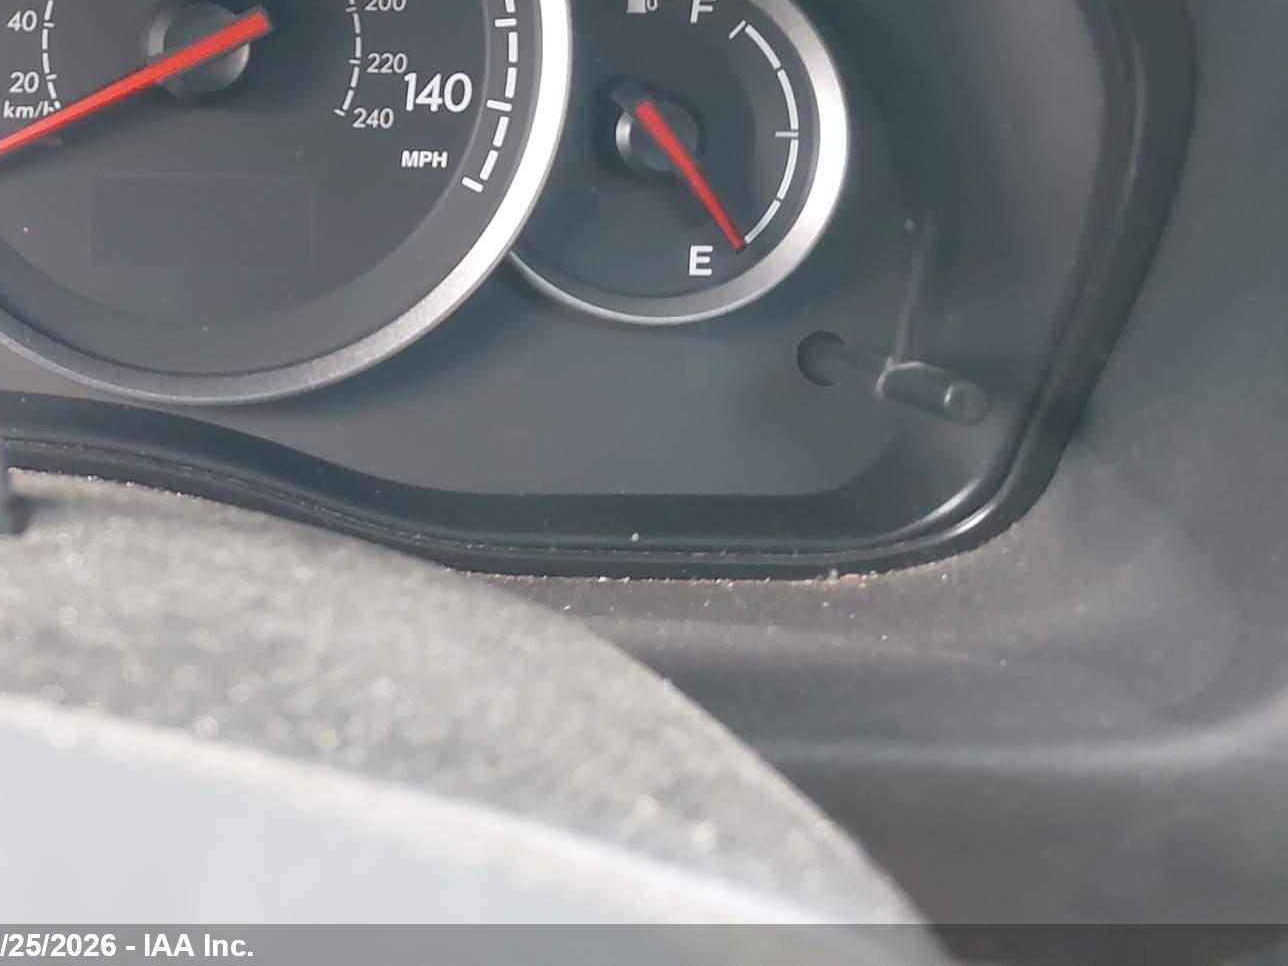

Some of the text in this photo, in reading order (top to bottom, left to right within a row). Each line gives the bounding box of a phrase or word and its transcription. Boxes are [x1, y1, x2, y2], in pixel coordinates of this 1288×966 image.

[7, 10, 37, 31] 40
[367, 53, 407, 73] 220
[9, 72, 39, 93] 20
[404, 73, 472, 112] 140
[353, 108, 393, 128] 240
[402, 151, 447, 168] MPH
[689, 246, 713, 275] E
